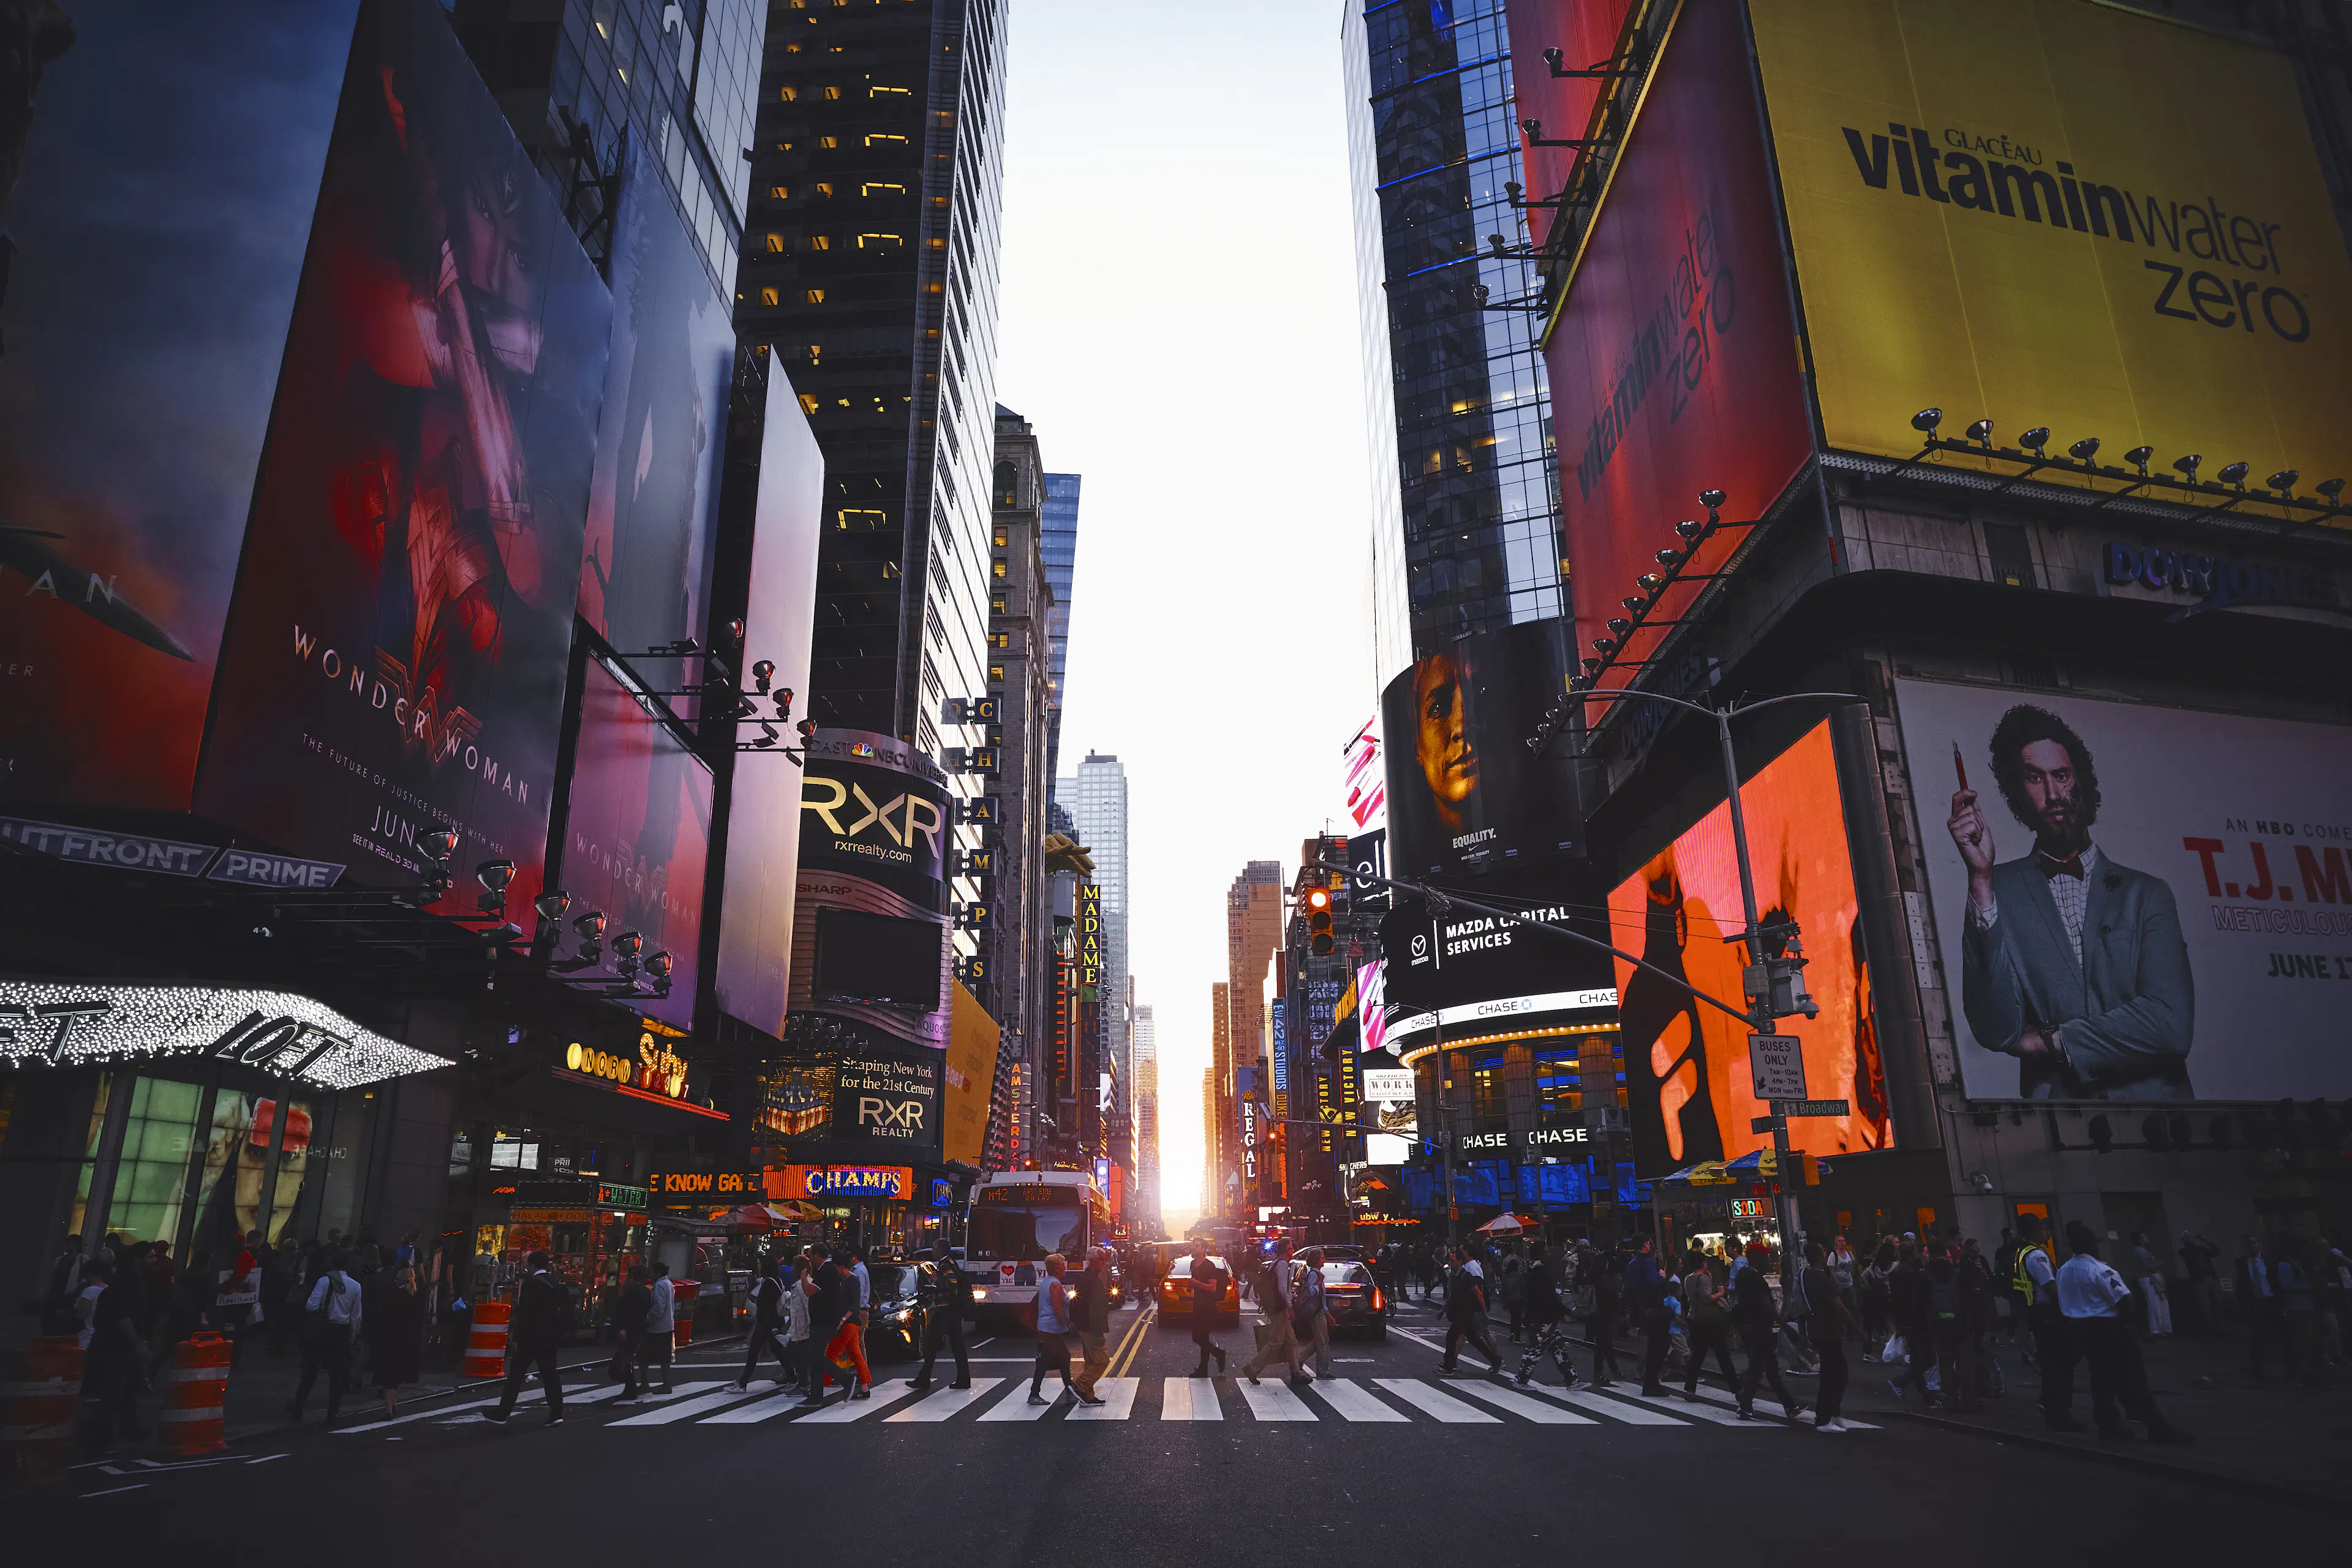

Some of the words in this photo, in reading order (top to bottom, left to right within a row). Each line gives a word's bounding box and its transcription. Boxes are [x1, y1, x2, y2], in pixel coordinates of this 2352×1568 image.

[1842, 123, 2280, 275] vitaminwater
[2144, 260, 2311, 343] zero
[1665, 264, 1735, 426] zero
[2103, 541, 2215, 595] DOW
[0, 564, 118, 605] AN
[294, 624, 429, 739] WONDER
[446, 729, 528, 805] WOMAN
[303, 733, 323, 753] THE
[330, 748, 368, 778] FUTURE
[374, 774, 386, 788] OF
[391, 785, 428, 812] JUSTICE
[432, 807, 463, 832] BEGINS
[467, 827, 486, 845] WITH
[490, 840, 503, 855] HER
[371, 805, 417, 848] JUN
[801, 776, 941, 859] RXR
[2226, 818, 2248, 832] AN
[2256, 820, 2295, 836] HBO
[972, 702, 993, 978] CHAMPS
[1453, 828, 1497, 848] EQUALITY.
[835, 840, 913, 863] rxrrealty.com
[226, 854, 331, 888] PRIME
[577, 832, 643, 893] WONDER
[650, 887, 696, 927] WOMAN
[796, 884, 852, 895] SHARP
[1082, 886, 1099, 983] MADAME
[1446, 920, 1494, 939] MAZDA
[1447, 932, 1512, 956] SERVICES
[2268, 953, 2331, 979] JUNE
[1273, 1005, 1284, 1017] EW
[1478, 1001, 1518, 1016] CHASE
[917, 1021, 943, 1035] AQUOS
[1411, 1014, 1436, 1029] CHASE
[208, 1009, 351, 1078] LOFT
[1759, 1041, 1790, 1052] BUSES
[842, 1057, 891, 1076] Shaping
[893, 1061, 915, 1076] New
[917, 1064, 933, 1079] York
[1275, 1052, 1287, 1090] STUDIOS
[1765, 1054, 1788, 1066] ONLY
[841, 1074, 860, 1088] for
[862, 1076, 880, 1090] the
[883, 1079, 903, 1092] 21st
[904, 1081, 935, 1099] Century
[1342, 1049, 1355, 1103] VICTORY
[1371, 1080, 1413, 1090] WORK
[858, 1096, 924, 1129] RXR
[1800, 1102, 1846, 1115] Broadway
[872, 1126, 914, 1138] REALTY
[1344, 1111, 1357, 1137] NW
[1243, 1102, 1256, 1178] REGAL
[1321, 1129, 1331, 1152] NEW
[1463, 1133, 1508, 1150] CHASE
[1529, 1128, 1589, 1145] CHASE
[665, 1174, 713, 1192] KNOW
[806, 1170, 901, 1194] CHAMPS
[611, 1187, 641, 1205] WATER
[989, 1188, 1009, 1201] M42
[1360, 1213, 1389, 1221] ubwy
[1733, 1200, 1763, 1216] SODA
